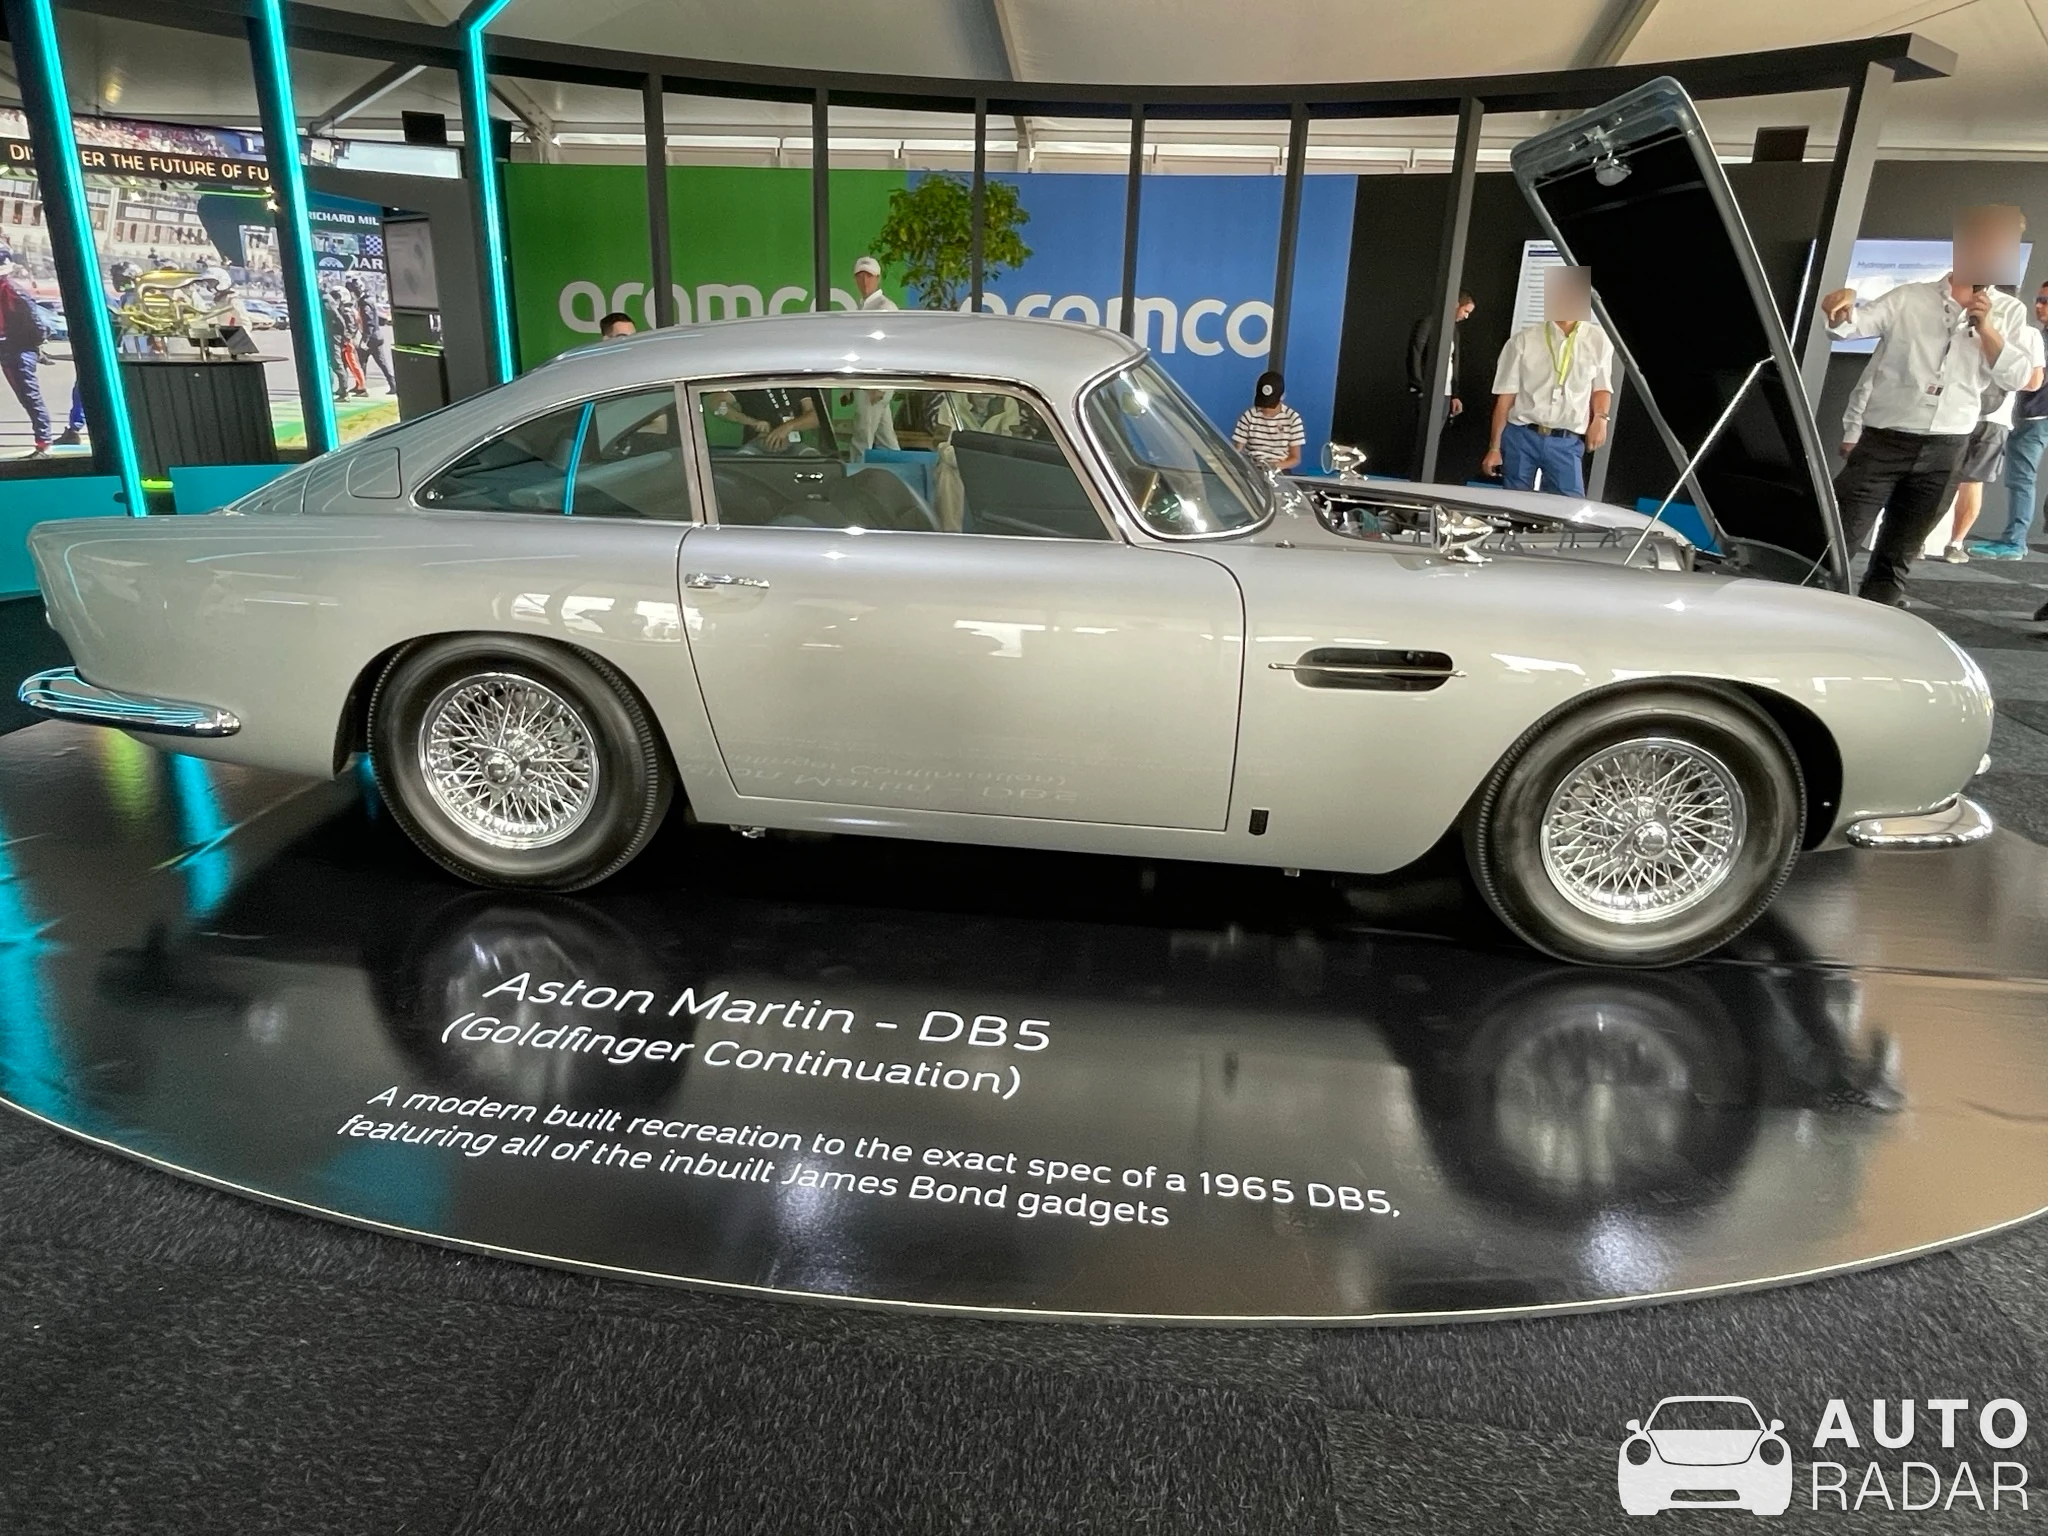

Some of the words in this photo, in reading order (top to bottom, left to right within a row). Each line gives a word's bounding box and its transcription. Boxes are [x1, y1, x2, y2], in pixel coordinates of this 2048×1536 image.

[110, 152, 145, 171] THE
[150, 156, 217, 177] FUTURE
[221, 162, 243, 179] OF
[307, 211, 355, 224] RICHARD
[482, 972, 655, 1014] Aston
[669, 988, 855, 1034] Martin
[919, 1011, 1051, 1052] DB5
[442, 1013, 696, 1064] (Goldfinger
[704, 1041, 1021, 1100] Continuation)
[337, 1115, 498, 1157] featuring
[501, 1134, 550, 1157] all
[551, 1139, 595, 1162] of
[592, 1143, 653, 1169] the
[659, 1150, 776, 1185] inbuilt
[780, 1162, 899, 1198] James
[909, 1175, 1008, 1209] Bond
[1016, 1192, 1170, 1227] gadgets
[367, 1086, 398, 1107] A
[402, 1094, 538, 1123] modern
[543, 1104, 622, 1132] built
[627, 1118, 803, 1152] recreation
[811, 1133, 846, 1156] to
[855, 1137, 913, 1163] the
[922, 1148, 1018, 1175] exact
[1028, 1159, 1112, 1185] spec
[1122, 1165, 1158, 1189] of
[1165, 1173, 1187, 1192] a
[1200, 1172, 1295, 1204] 1965
[1307, 1183, 1401, 1218] DB5,
